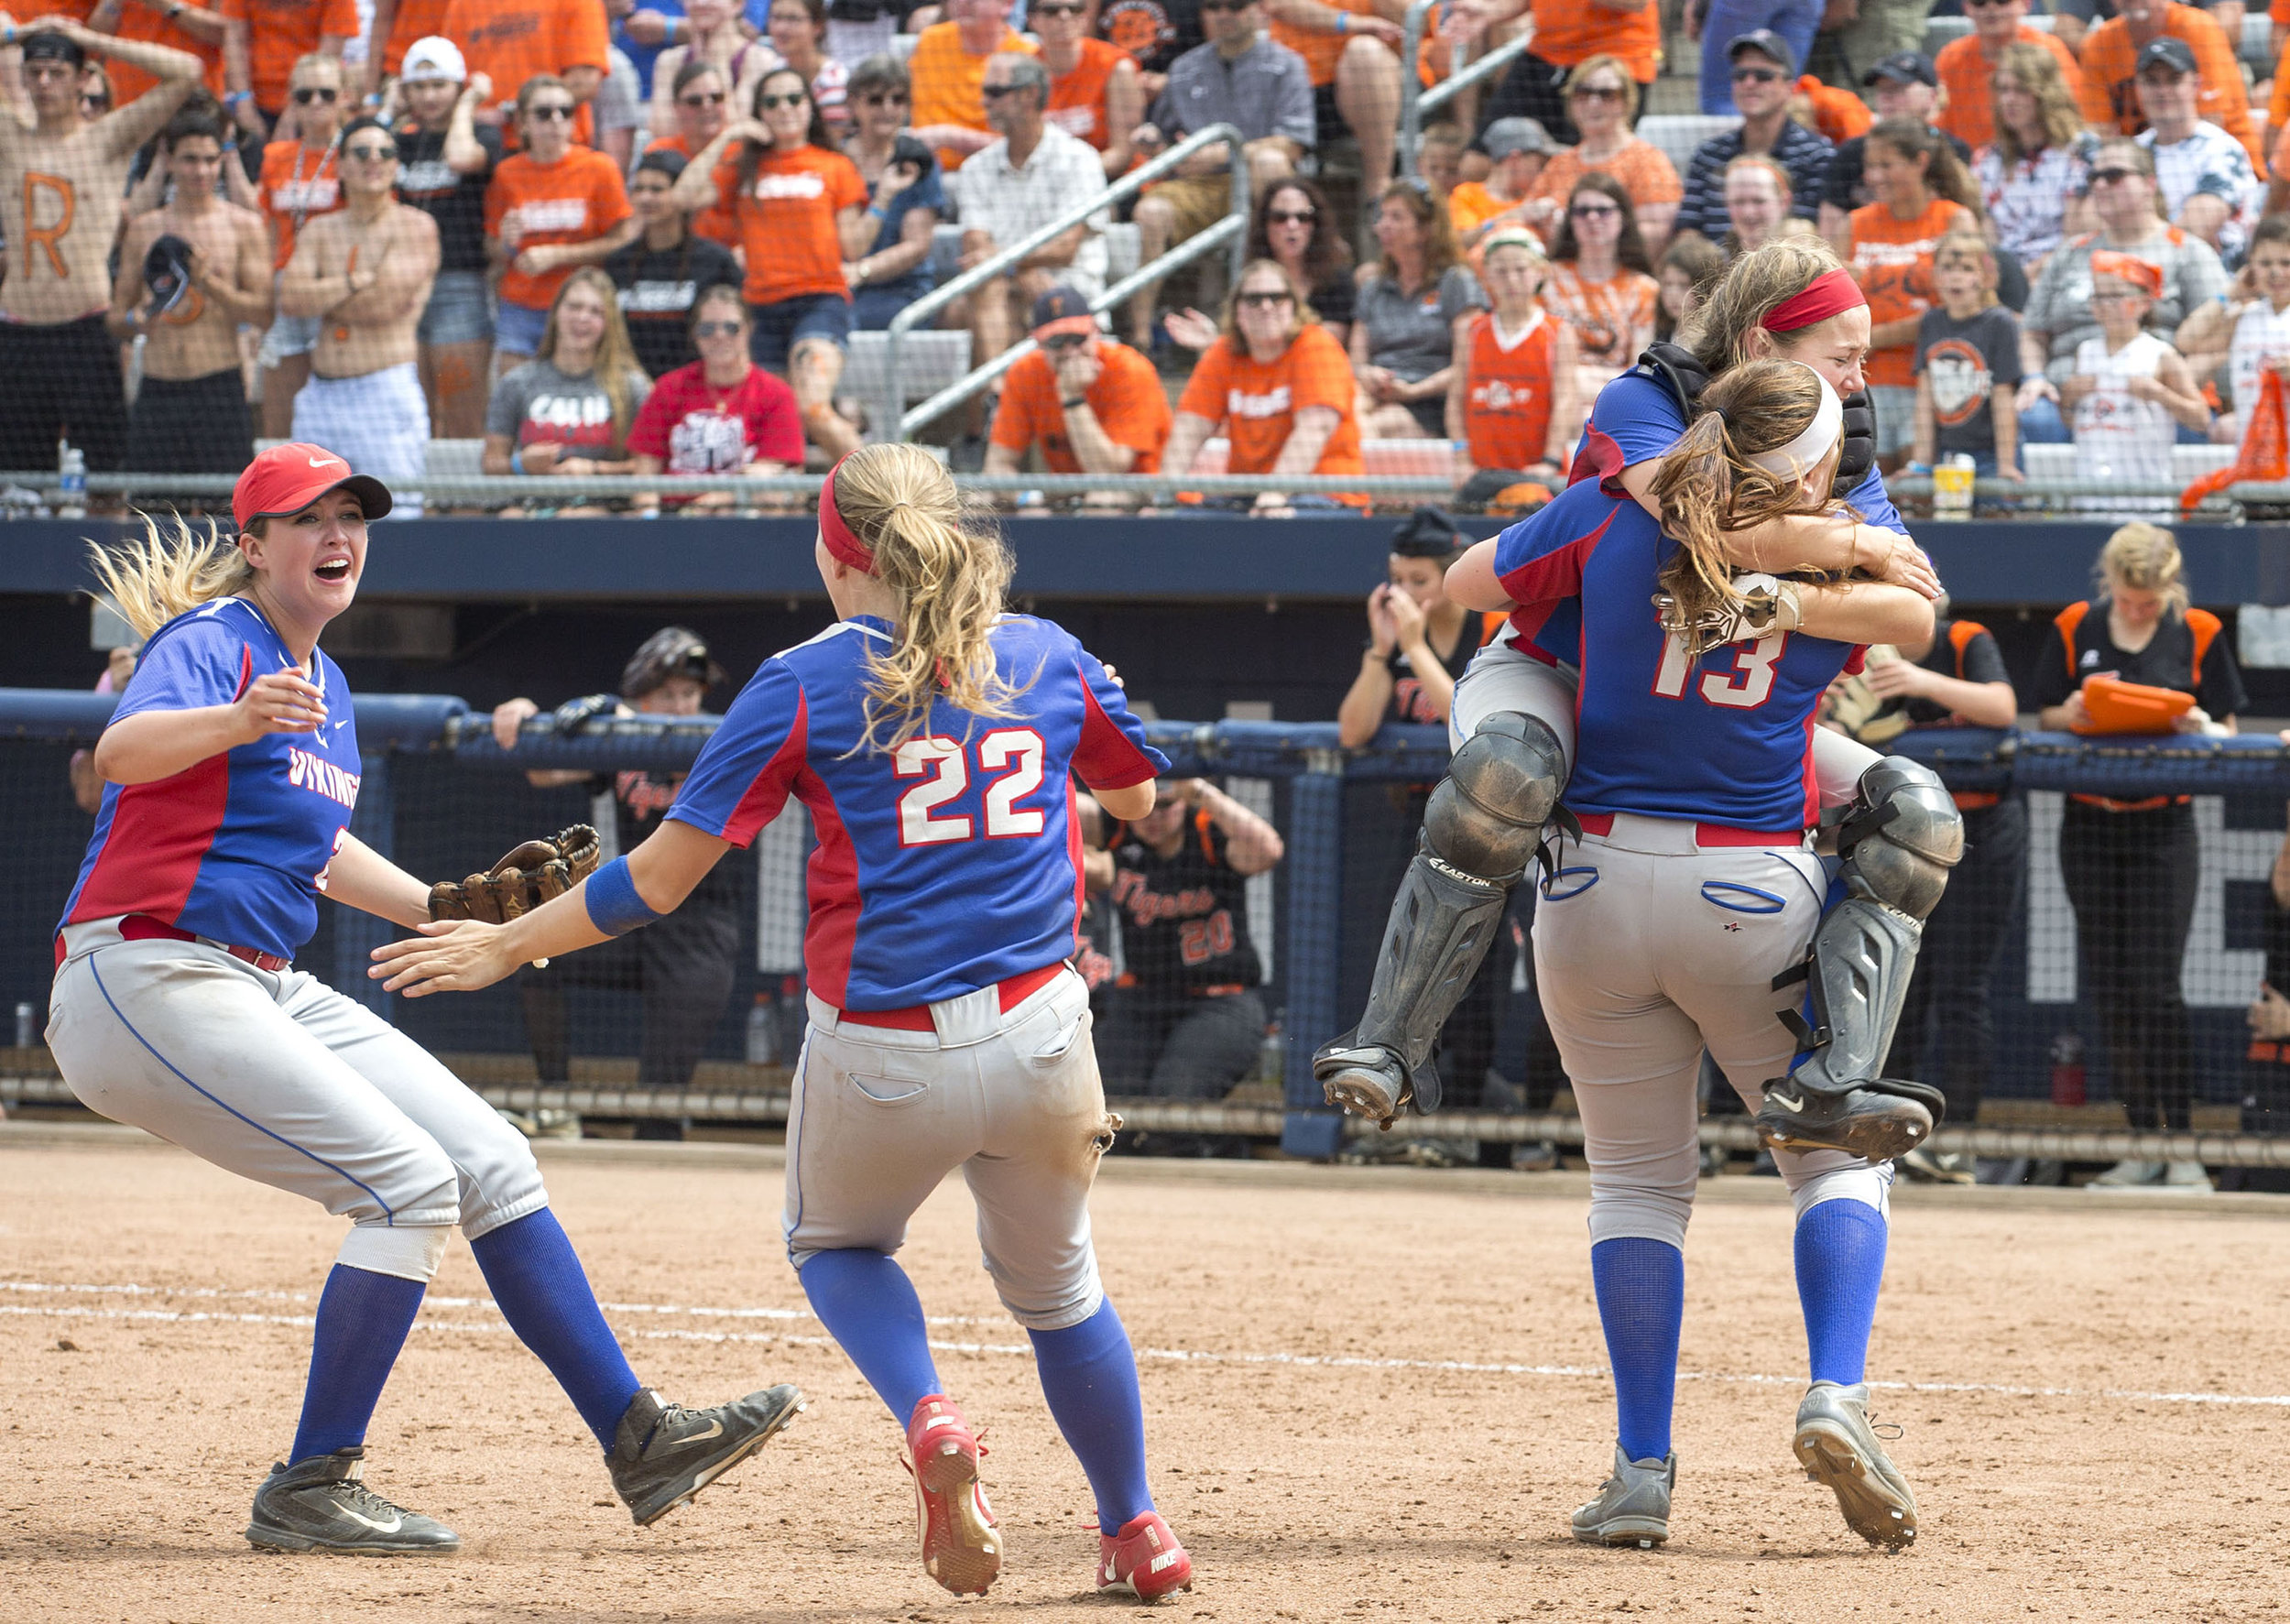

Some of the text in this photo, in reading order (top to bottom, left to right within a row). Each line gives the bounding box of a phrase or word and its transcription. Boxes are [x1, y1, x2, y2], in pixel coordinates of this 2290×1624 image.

[24, 171, 75, 278] R
[1651, 599, 1791, 712] 13
[890, 725, 1046, 849] 22
[1113, 868, 1216, 928] Tigers
[1436, 863, 1492, 888] EASTON
[1179, 909, 1236, 967] 20
[1150, 1548, 1178, 1575] NIKE
